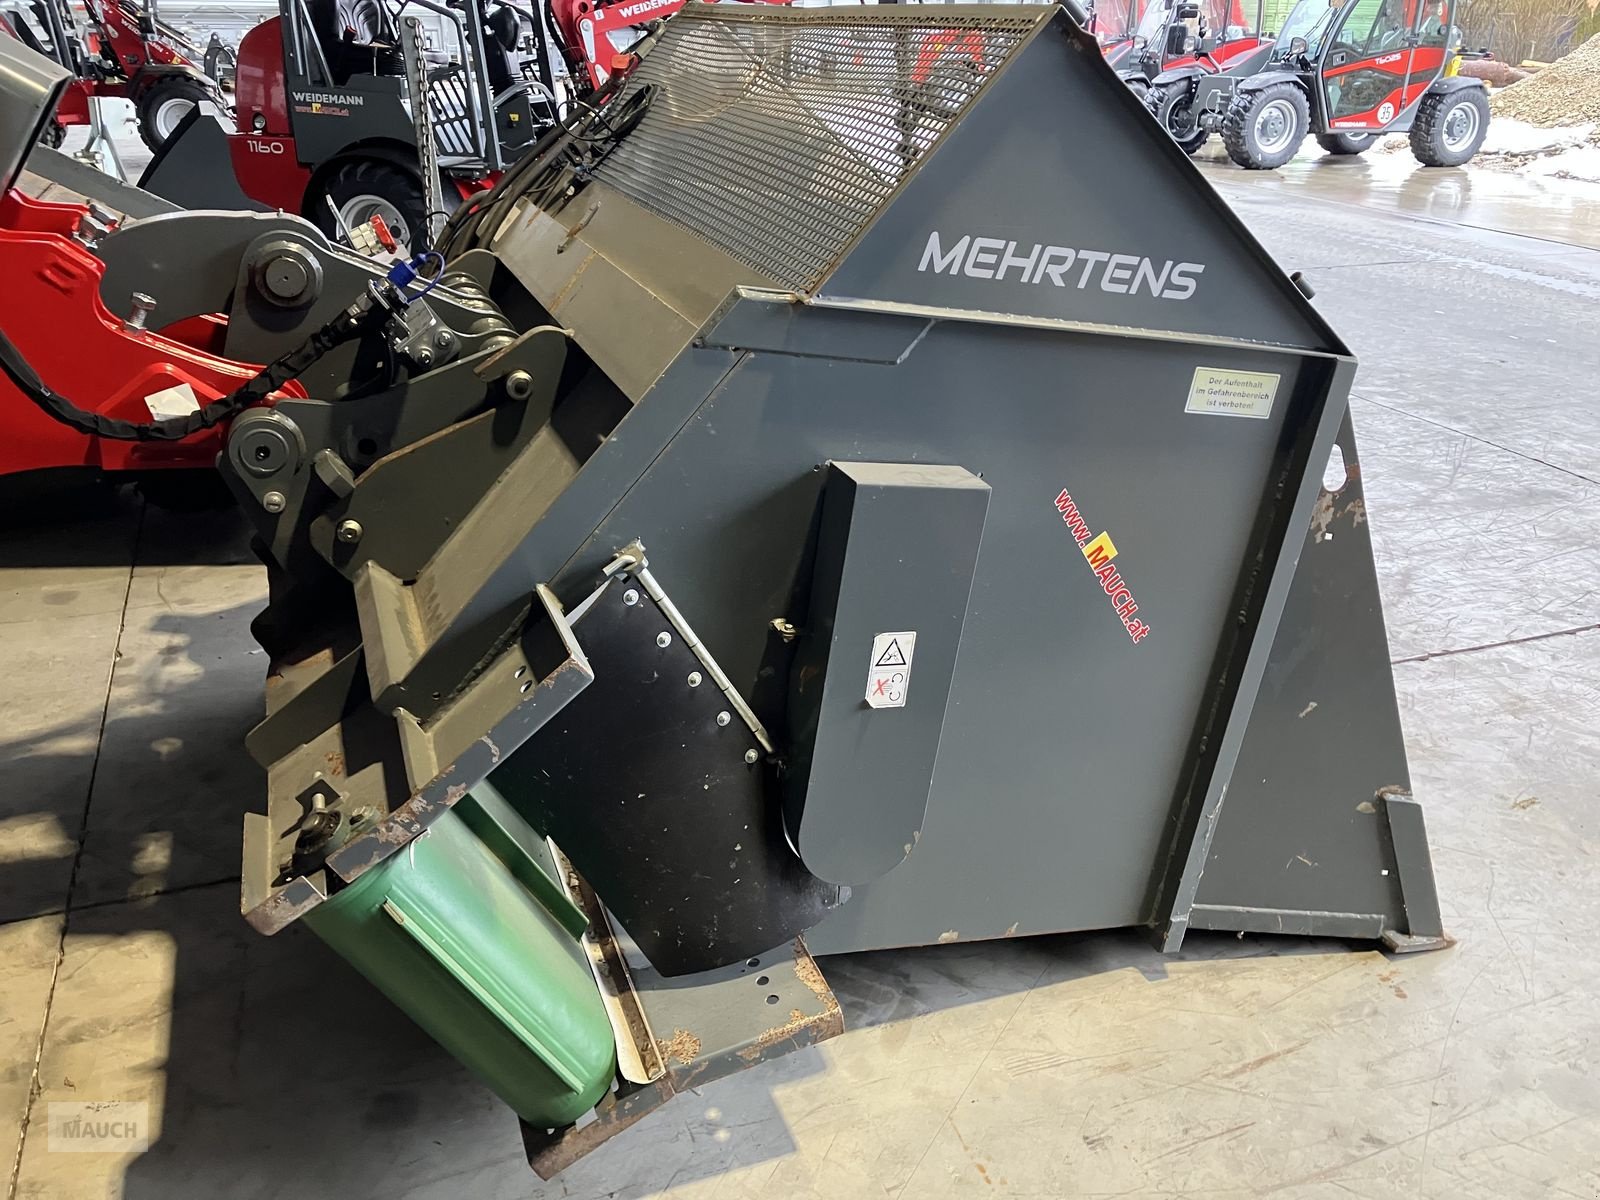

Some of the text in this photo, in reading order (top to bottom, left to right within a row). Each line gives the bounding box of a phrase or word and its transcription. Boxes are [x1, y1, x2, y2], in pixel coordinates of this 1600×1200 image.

[292, 91, 364, 106] WEIDEMANN
[1381, 106, 1391, 120] 35
[247, 140, 284, 154] 1160
[917, 231, 1206, 300] MEHRTENS
[1208, 377, 1263, 389] Der Aufenthalt
[1195, 387, 1270, 400] im Gefahrenbereich
[1206, 399, 1254, 409] ist verboten!
[1054, 487, 1150, 644] www.MAUCH.at
